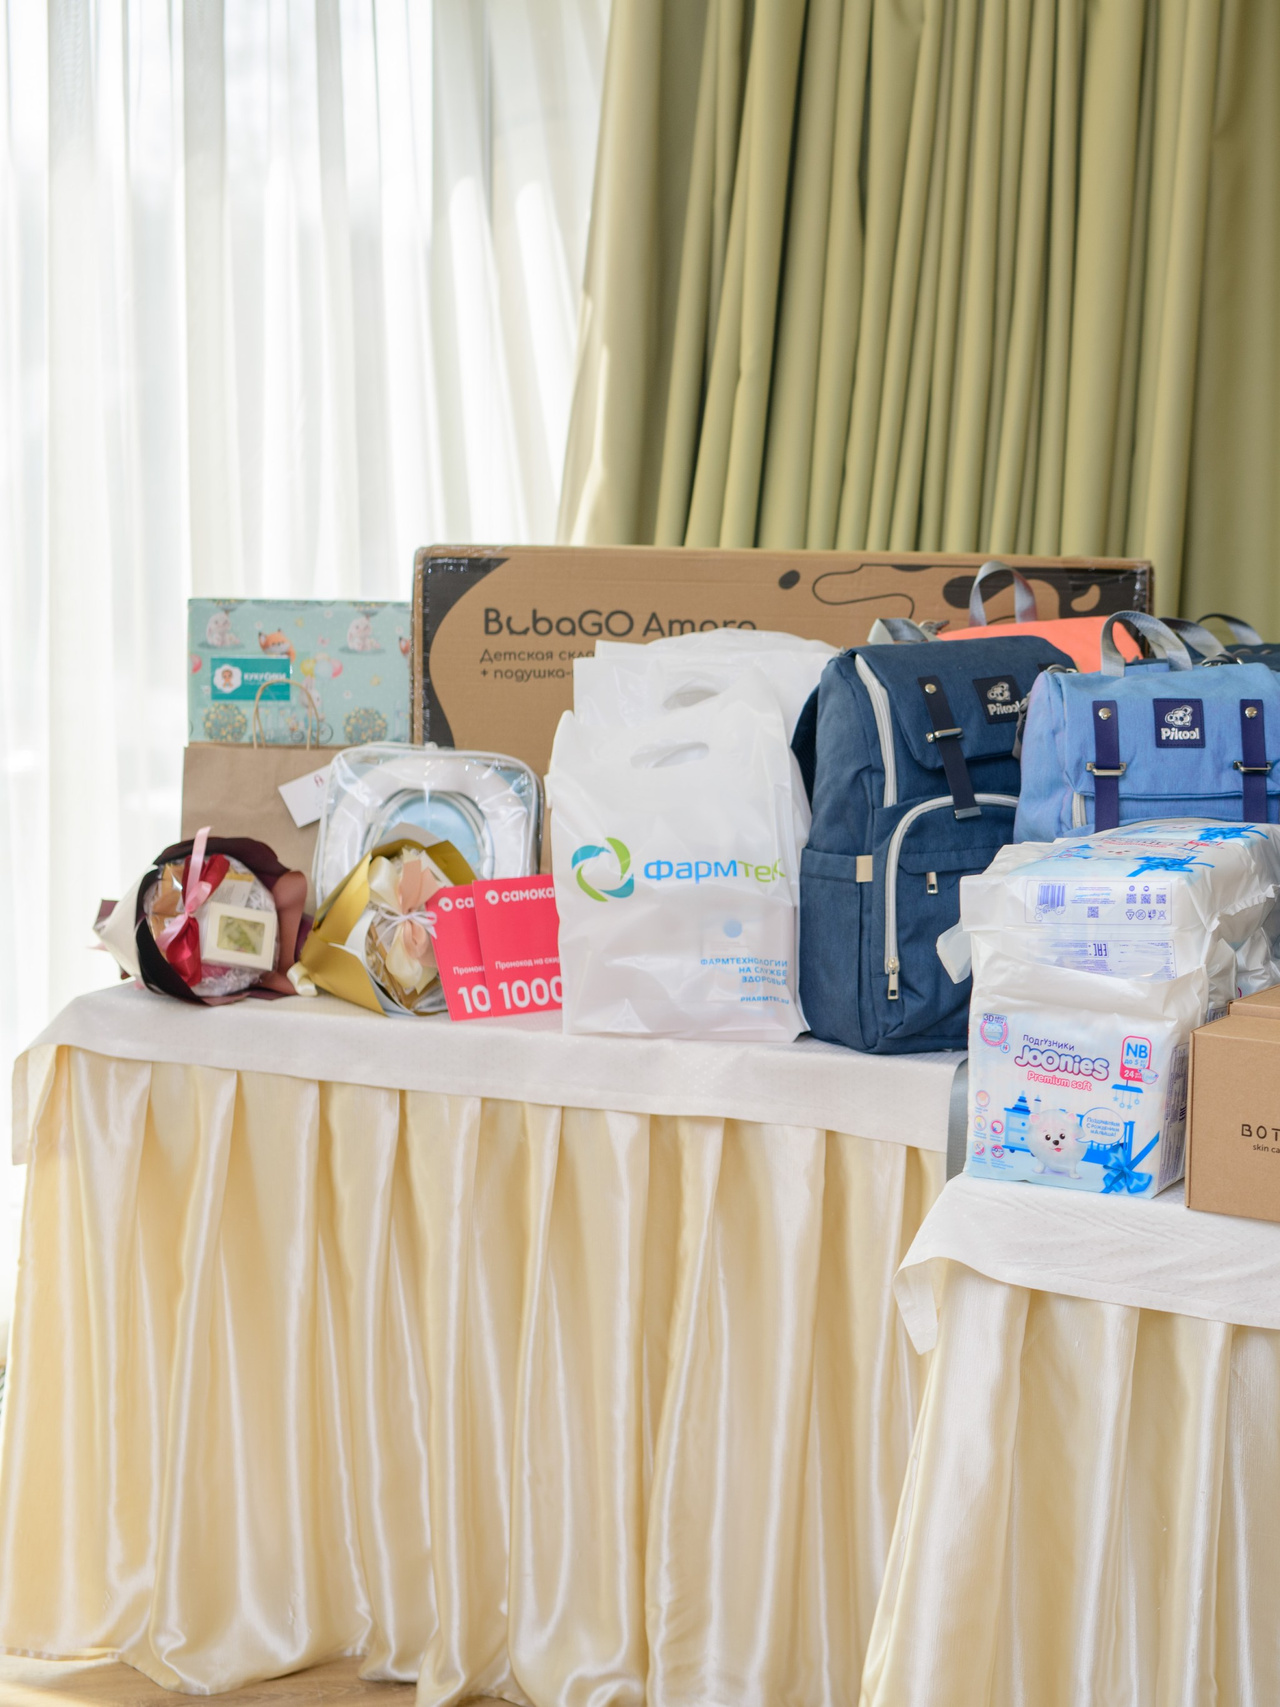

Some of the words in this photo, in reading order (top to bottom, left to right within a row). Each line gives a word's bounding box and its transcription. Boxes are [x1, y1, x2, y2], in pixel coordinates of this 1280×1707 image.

[484, 608, 634, 637] BubaGO
[480, 649, 553, 664] Детская
[494, 668, 574, 682] подушка-
[1160, 727, 1200, 740] Pikool
[496, 958, 533, 970] Промокод
[700, 958, 788, 967] ФАРМТЕХНОЛОГИИ
[739, 966, 752, 974] НА
[754, 966, 788, 976] СЛУЖБЕ
[742, 976, 786, 986] ЗДОРОВЬЯ
[984, 1013, 994, 1022] 3D
[1126, 1042, 1148, 1058] NB
[1124, 1070, 1134, 1078] 24
[1027, 1070, 1071, 1088] Premium
[1071, 1080, 1092, 1092] soft
[1252, 1144, 1270, 1152] skin
